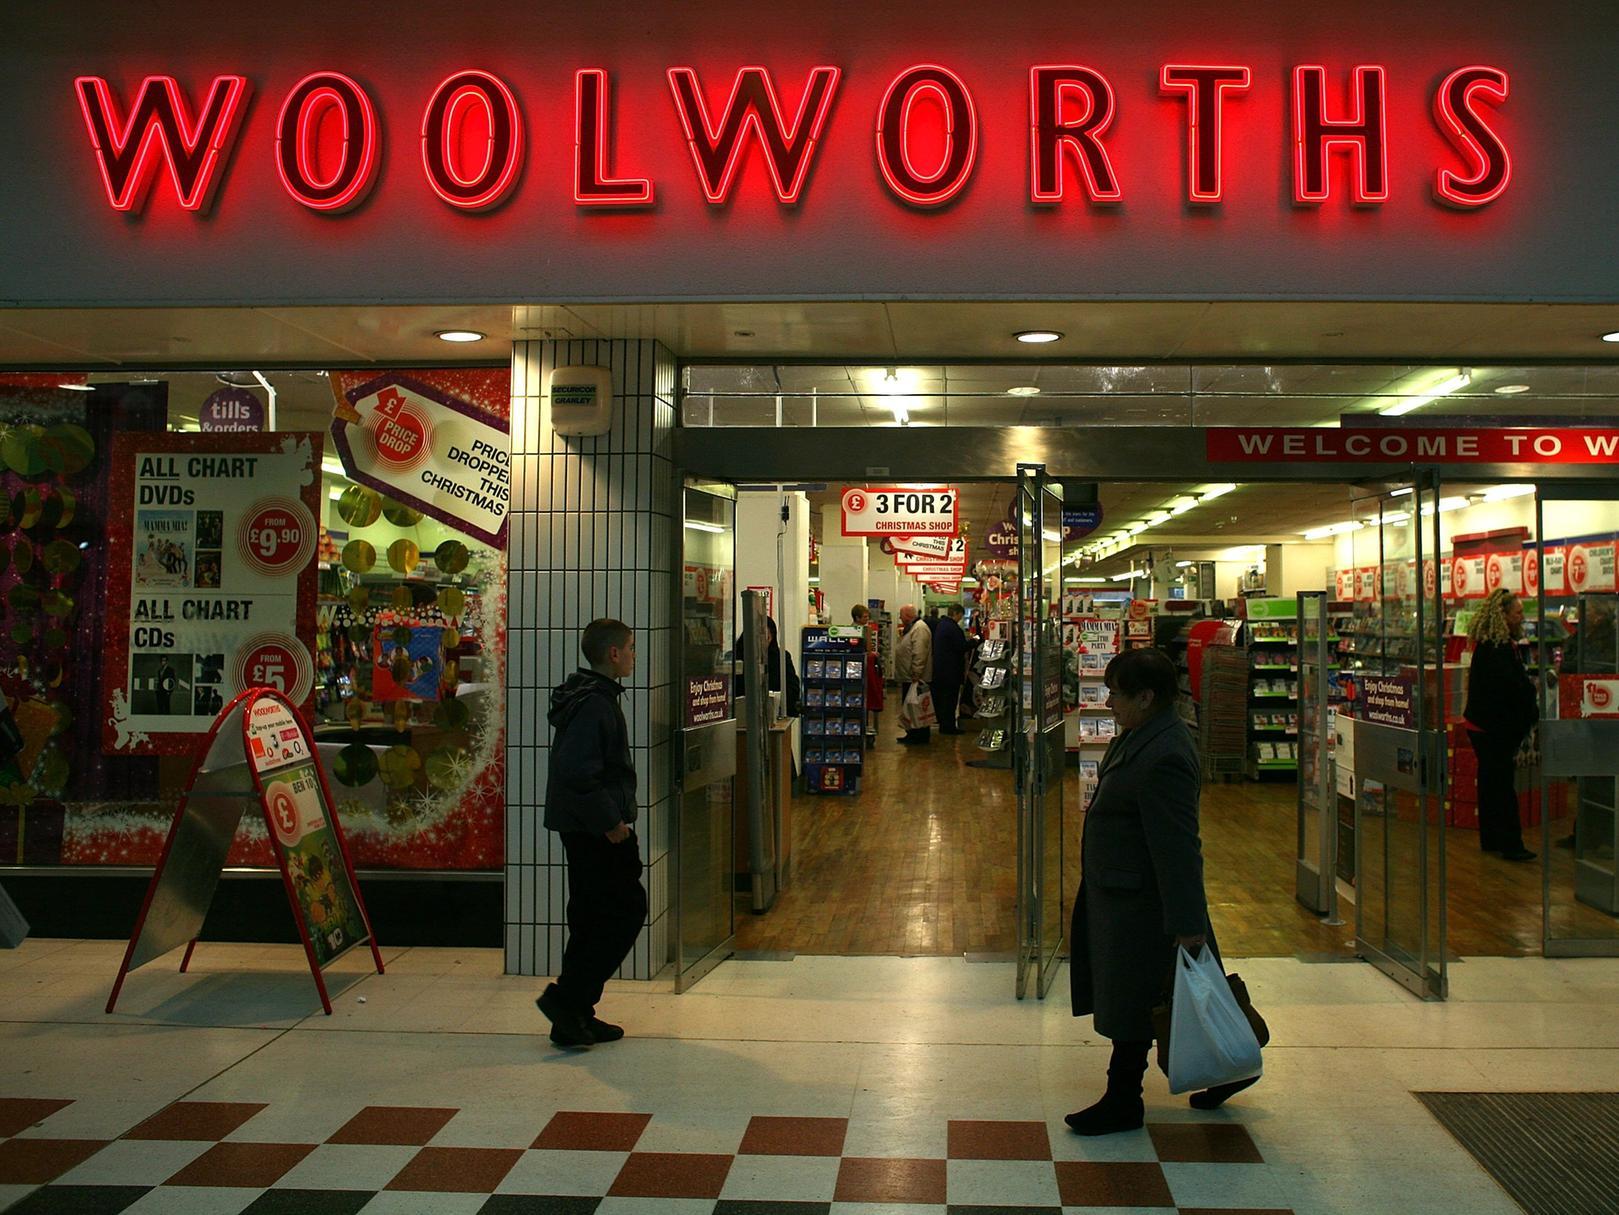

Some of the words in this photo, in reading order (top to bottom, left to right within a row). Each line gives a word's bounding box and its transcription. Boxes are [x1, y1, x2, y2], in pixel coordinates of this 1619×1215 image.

[74, 63, 1513, 214] WOOLWORTHS
[211, 400, 250, 419] tills
[383, 420, 419, 446] PRICE
[378, 433, 412, 455] DROP
[471, 439, 510, 467] PRIC
[1237, 434, 1480, 457] WELCOME
[1503, 434, 1563, 457] TO
[139, 456, 180, 478] ALL
[187, 457, 258, 478] CHART
[447, 446, 510, 484] DROPPE
[139, 485, 195, 505] DVDs
[421, 470, 505, 516] CHRISTMAS
[479, 477, 509, 501] THIS
[876, 494, 889, 514] 3
[893, 494, 935, 514] FOR
[939, 494, 953, 514] 2
[143, 520, 170, 532] MAMMA
[264, 517, 286, 526] FROM
[875, 521, 927, 530] CHRISTMAS
[928, 521, 953, 530] SHOP
[250, 528, 300, 557] £9.90
[912, 541, 945, 552] CHRISTMAS
[134, 599, 175, 620] ALL
[182, 600, 253, 620] CHART
[134, 627, 175, 648] CDs
[260, 654, 282, 663] FROM
[252, 665, 285, 690] £5
[690, 680, 703, 696] Enjoy
[1364, 679, 1377, 695] Enjoy
[1378, 680, 1404, 695] Christmas
[292, 779, 306, 794] BEN
